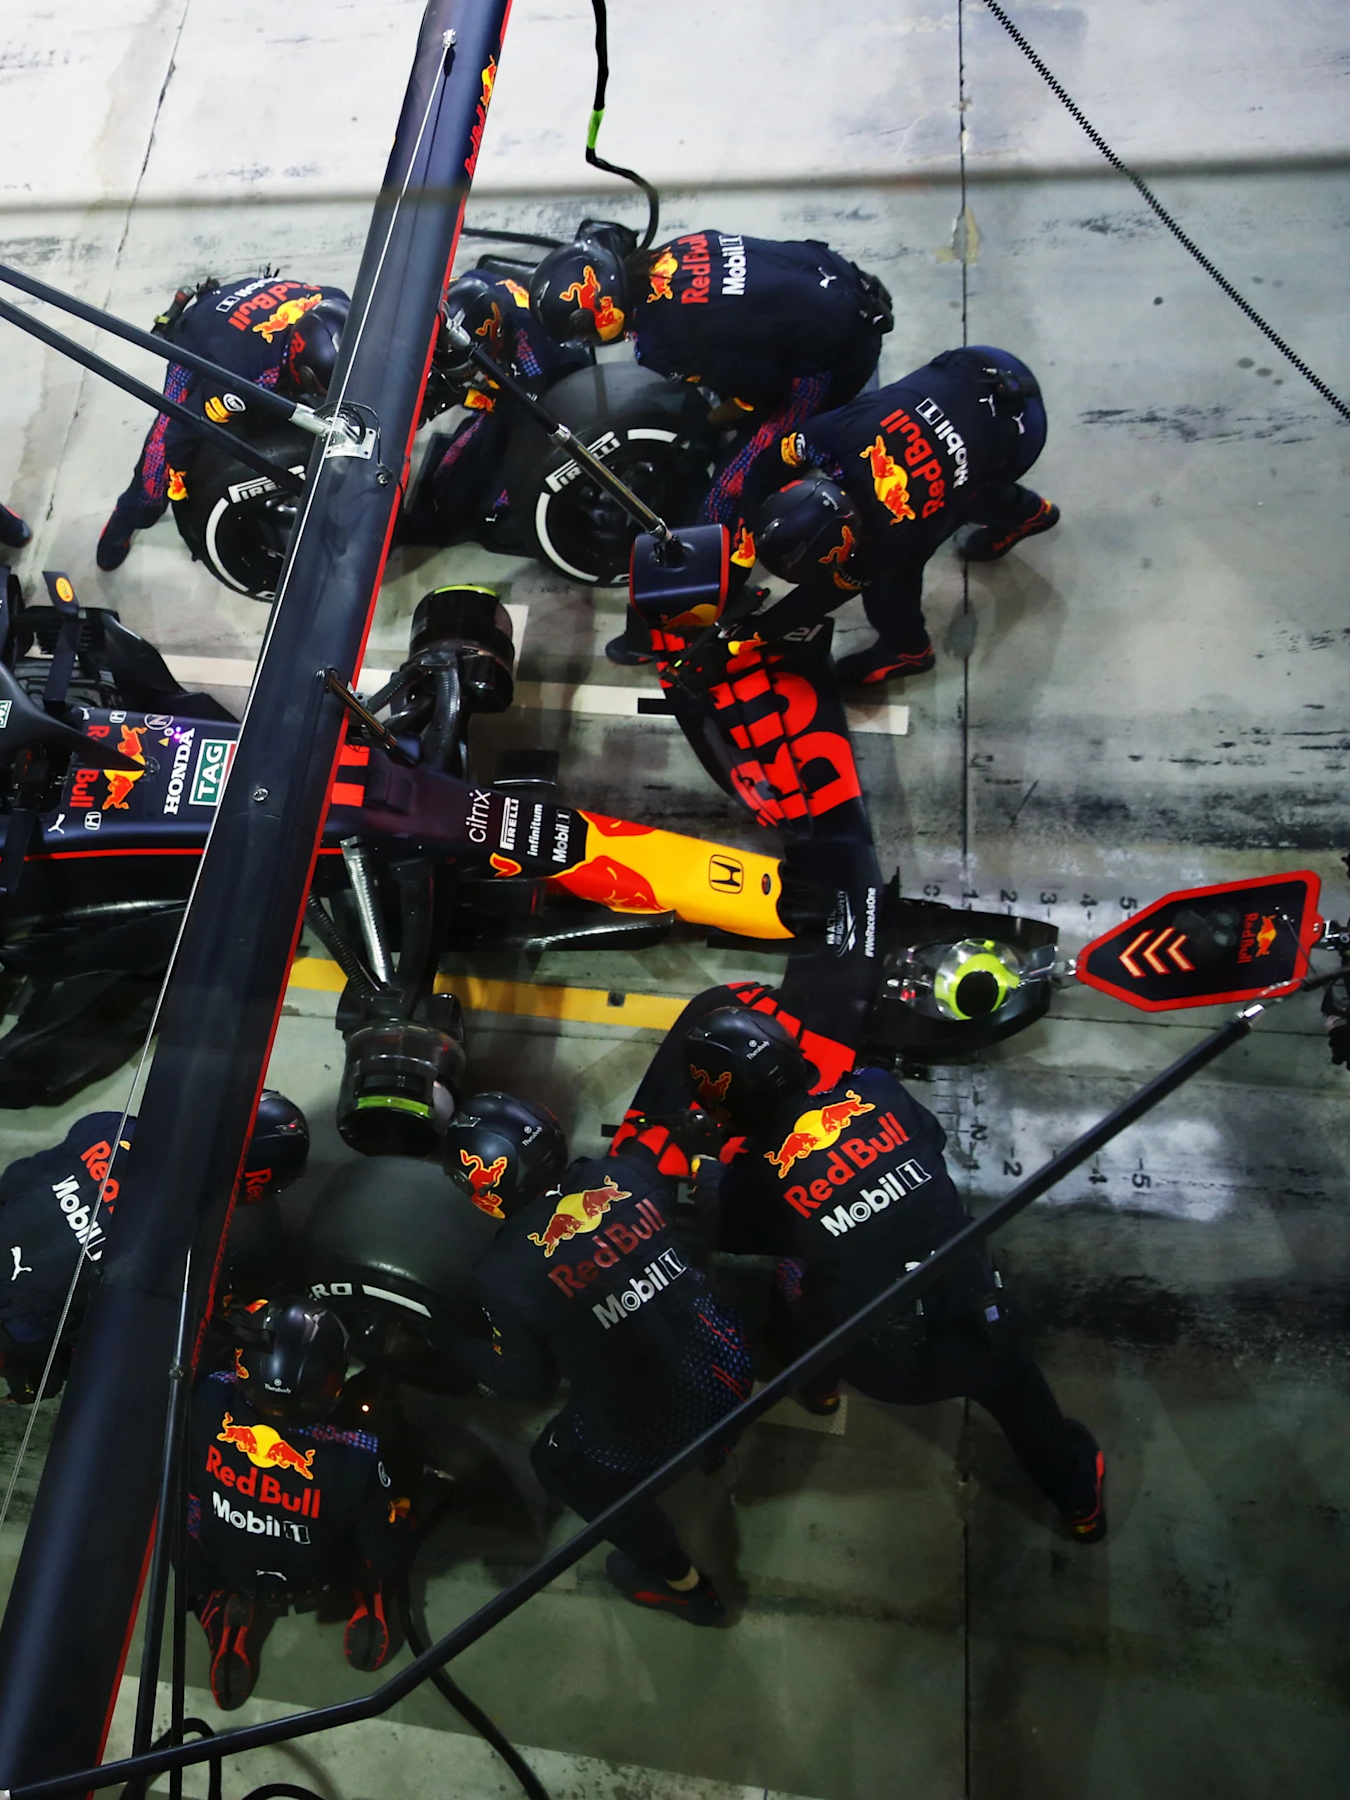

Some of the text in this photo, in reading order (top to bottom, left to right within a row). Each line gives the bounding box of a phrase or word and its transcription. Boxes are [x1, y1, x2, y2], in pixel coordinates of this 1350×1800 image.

[681, 264, 711, 304] Red
[722, 250, 747, 296] Mobil
[228, 292, 278, 331] Bull
[915, 397, 944, 426] 1
[879, 408, 946, 519] Red Bull
[69, 769, 100, 808] Bull
[163, 728, 196, 815] HONDA
[197, 745, 224, 800] TAG
[465, 789, 492, 843] citrix
[499, 797, 520, 851] PIRELLI
[526, 803, 544, 857] infinitum
[551, 823, 570, 863] Mobil
[1000, 890, 1018, 903] 2
[1040, 892, 1058, 905] 3
[1120, 896, 1138, 910] 5
[783, 1111, 911, 1219] Red Bull
[1003, 1161, 1023, 1177] 2
[1132, 1173, 1152, 1189] 5
[819, 1158, 933, 1238] Mobil 1
[548, 1198, 667, 1298] Red Bull
[310, 1282, 353, 1300] RO
[591, 1247, 687, 1330] Mobil 1
[264, 1382, 292, 1394] Therabody
[205, 1444, 321, 1519] Red Bull
[212, 1490, 311, 1544] Mobil 1
